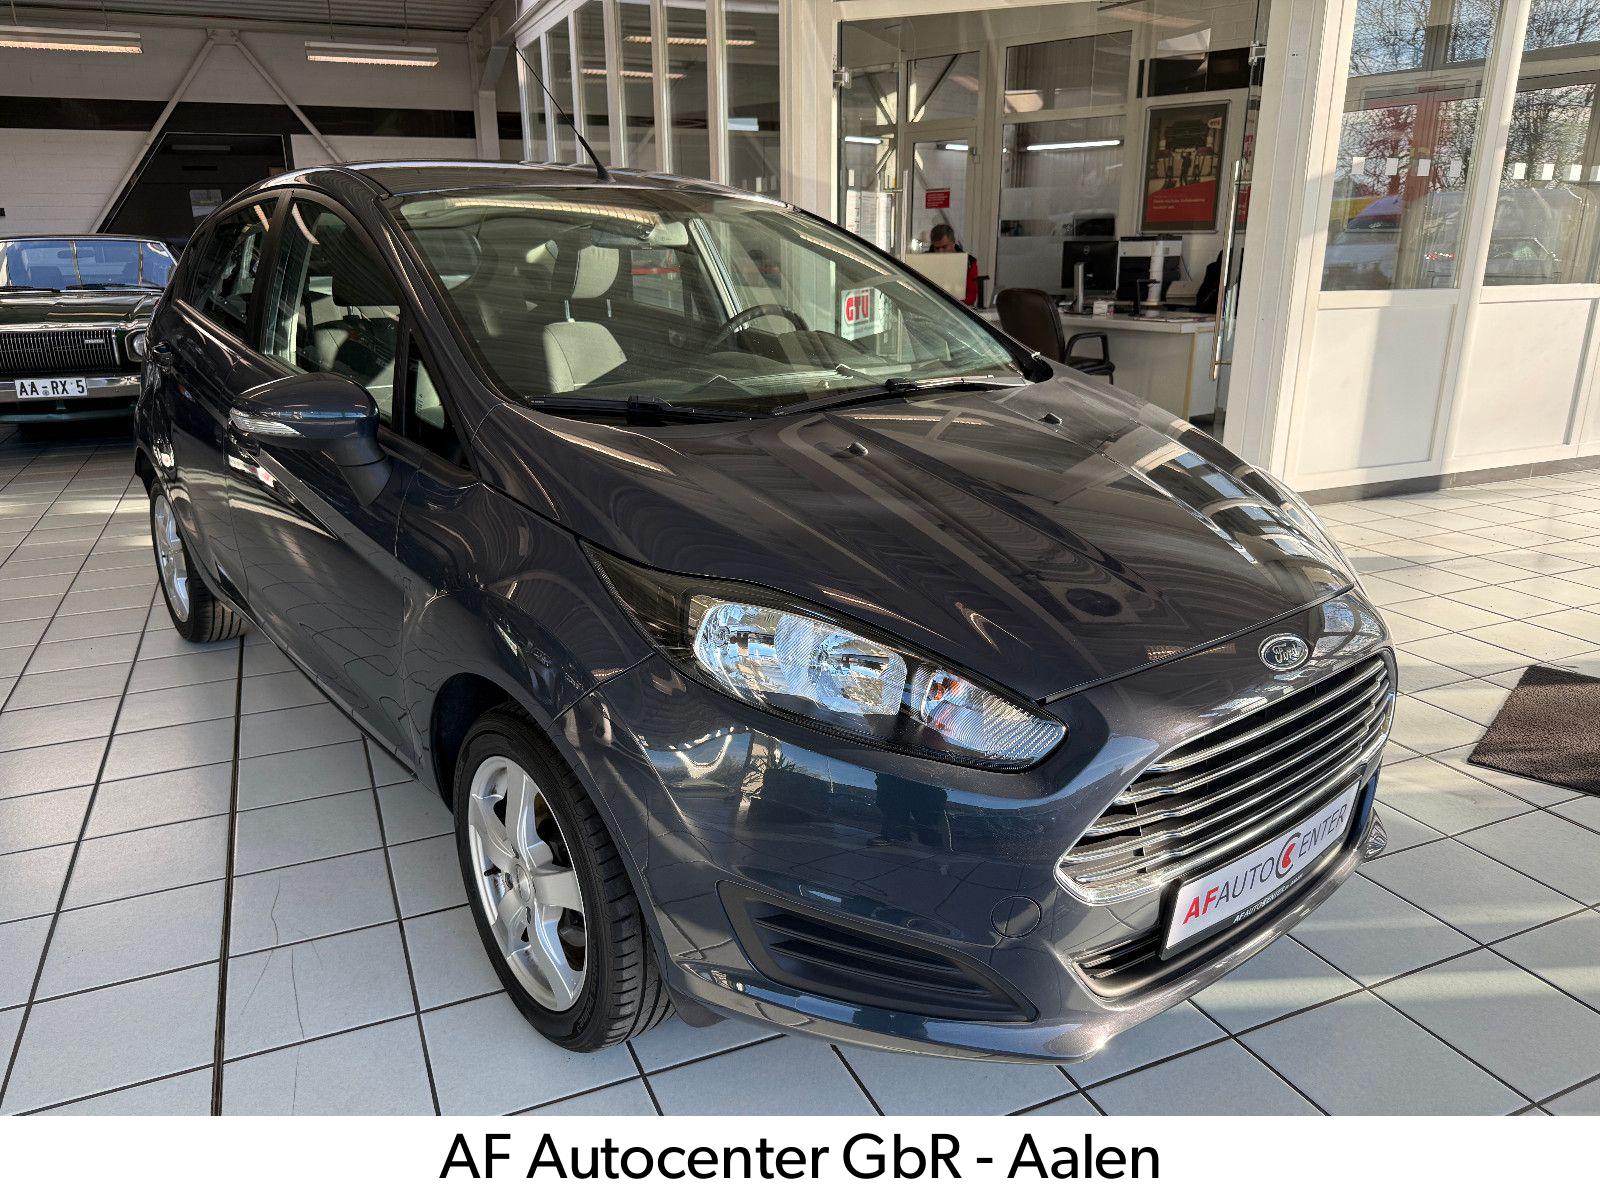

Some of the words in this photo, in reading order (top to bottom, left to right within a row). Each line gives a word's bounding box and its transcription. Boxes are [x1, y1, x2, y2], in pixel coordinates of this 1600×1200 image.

[846, 289, 869, 321] GTÜ
[76, 379, 85, 394] 5
[1272, 643, 1299, 663] Ford
